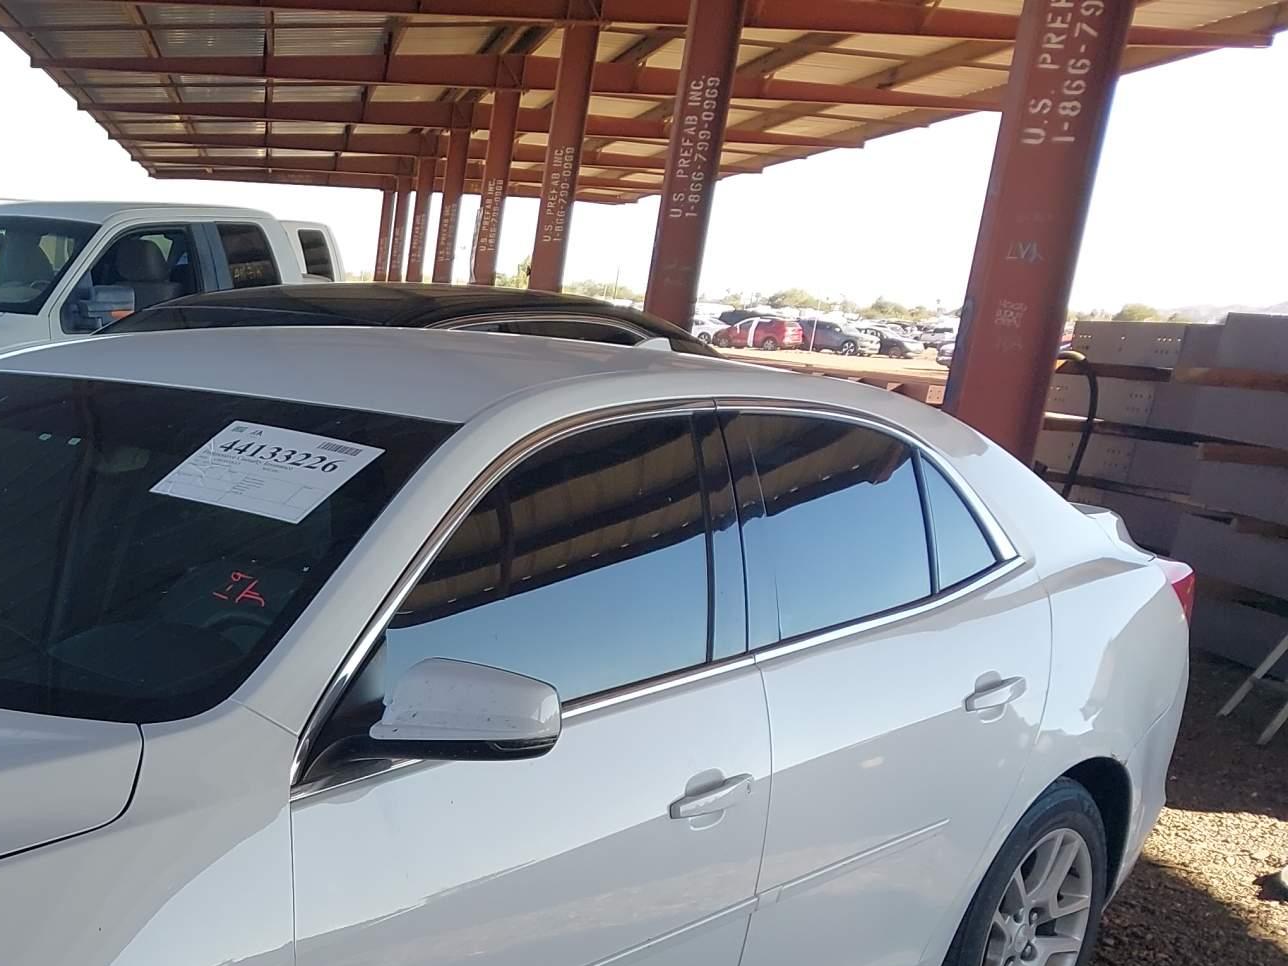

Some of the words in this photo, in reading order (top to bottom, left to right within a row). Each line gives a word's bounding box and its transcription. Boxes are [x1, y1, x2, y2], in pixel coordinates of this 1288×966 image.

[676, 115, 698, 178] PREFAB
[688, 75, 706, 107] INC.
[546, 172, 561, 216] PREFAB
[219, 440, 346, 473] 44133226
